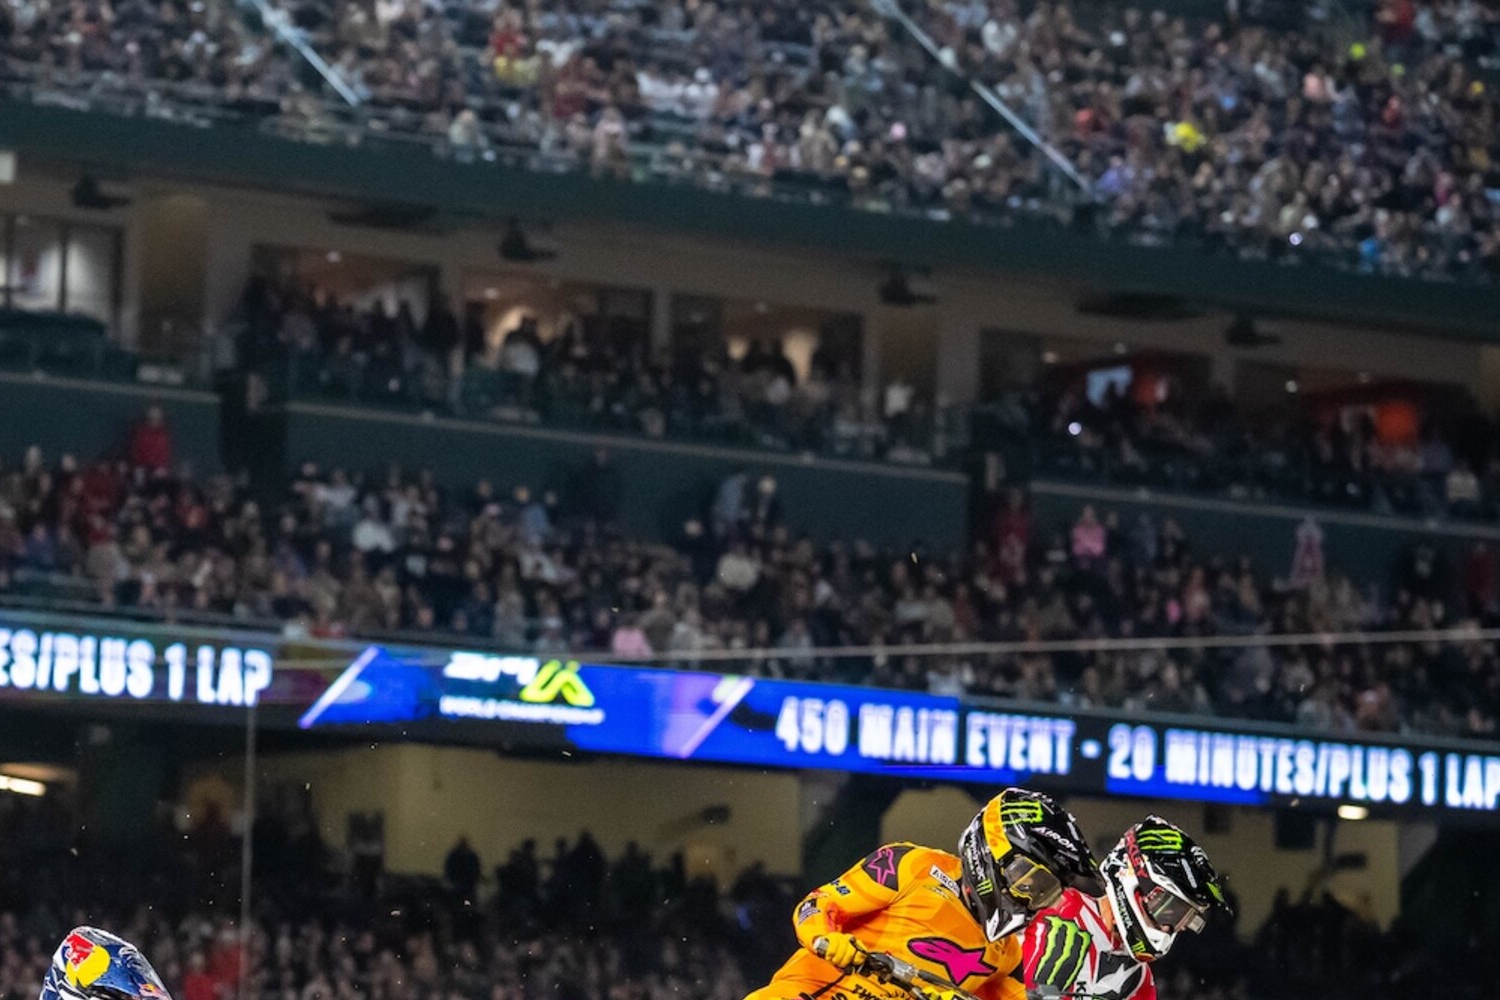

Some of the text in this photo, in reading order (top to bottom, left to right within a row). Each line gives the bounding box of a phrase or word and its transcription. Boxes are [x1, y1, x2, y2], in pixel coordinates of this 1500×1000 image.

[164, 642, 188, 701] 1
[195, 645, 274, 707] LAP
[775, 696, 850, 756] 450
[859, 702, 959, 765] MAIN
[966, 710, 1077, 775] EVENT
[1108, 722, 1157, 782] 20
[1165, 728, 1412, 803] MINUTES/PLUS
[1418, 750, 1439, 806] 1
